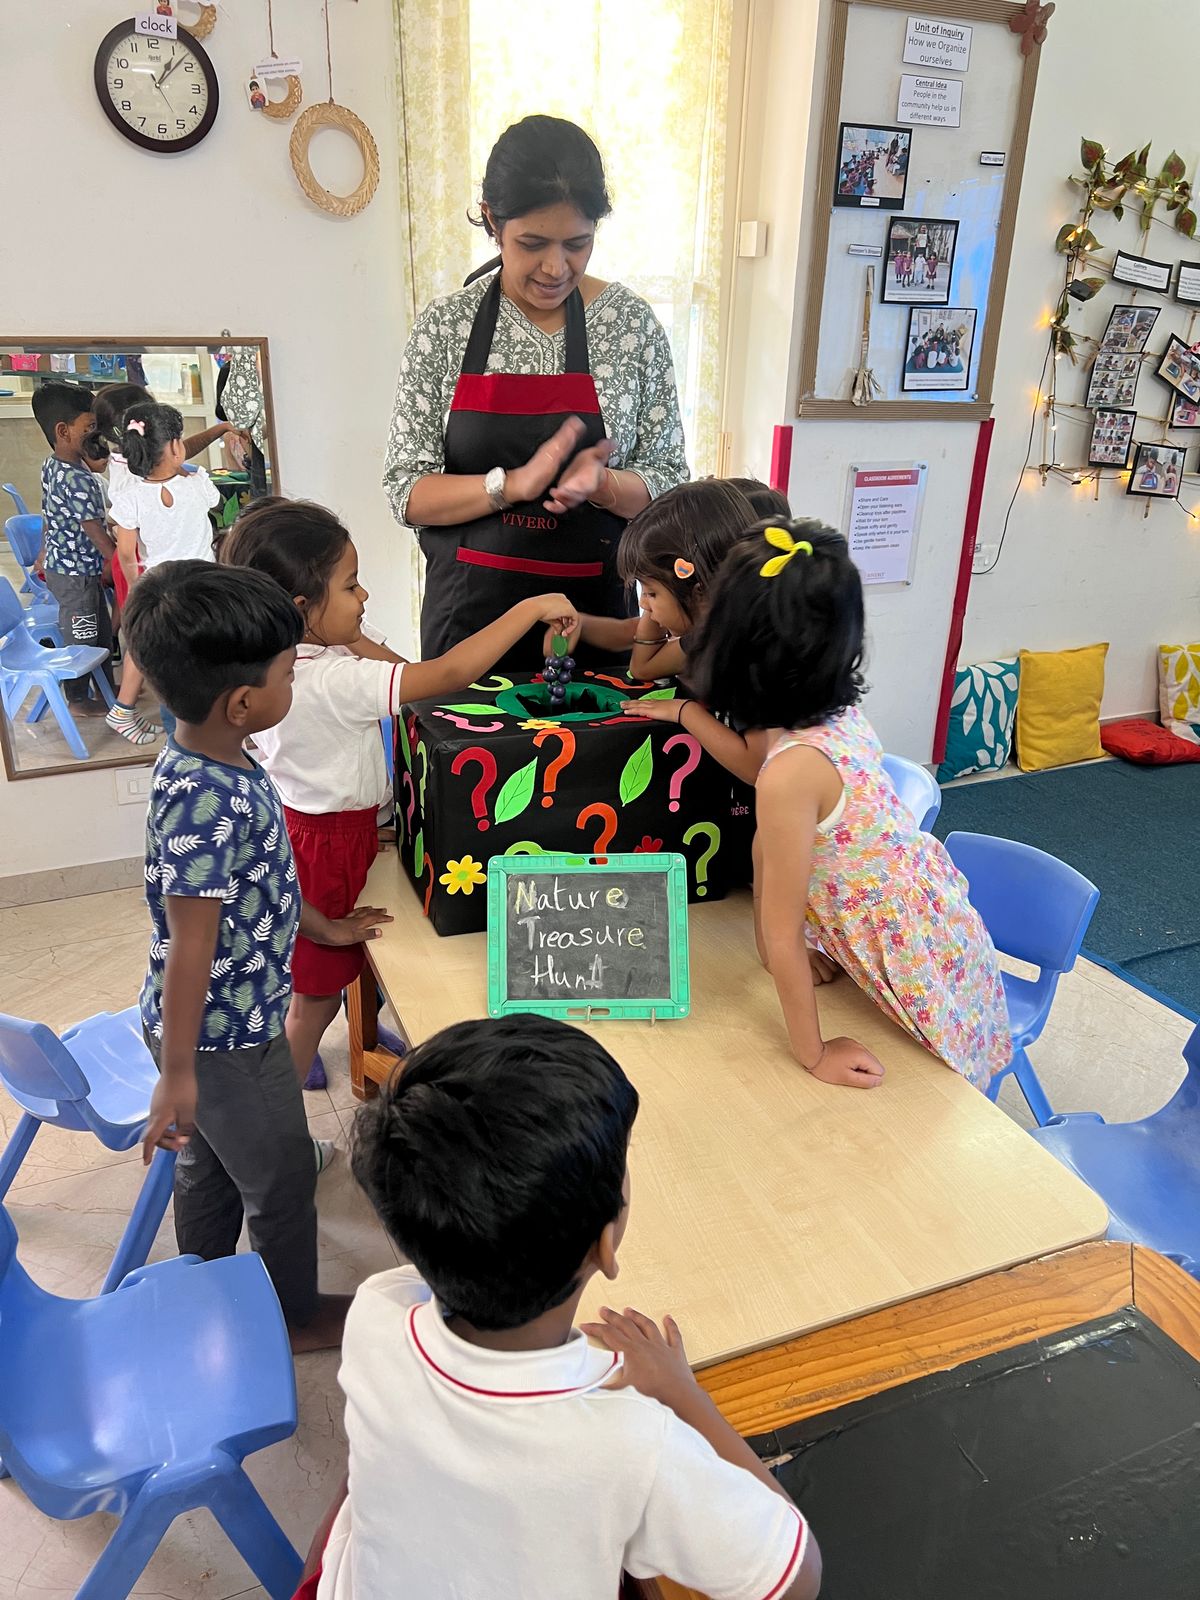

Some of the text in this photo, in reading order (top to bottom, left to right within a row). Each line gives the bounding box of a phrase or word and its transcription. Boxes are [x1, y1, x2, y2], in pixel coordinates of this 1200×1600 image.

[140, 17, 173, 33] clock
[914, 21, 965, 40] Unit of Inquiry
[130, 42, 138, 53] 11
[147, 38, 160, 50] 12
[908, 36, 967, 55] How we Organize
[116, 58, 129, 69] 10
[919, 54, 953, 67] ourselves
[183, 62, 194, 73] 2
[113, 79, 124, 89] 9
[191, 84, 202, 95] 3
[915, 78, 948, 90] Central Idea
[913, 89, 931, 99] People
[937, 92, 948, 100] the
[121, 100, 132, 111] 8
[188, 105, 198, 115] 4
[901, 101, 931, 112] community
[931, 105, 943, 113] help
[137, 116, 147, 127] 7
[909, 112, 947, 123] different ways
[157, 123, 167, 134] 6
[176, 119, 186, 130] 5
[502, 512, 558, 530] VIVERO
[514, 876, 630, 915] Nature
[516, 915, 648, 951] Treasure
